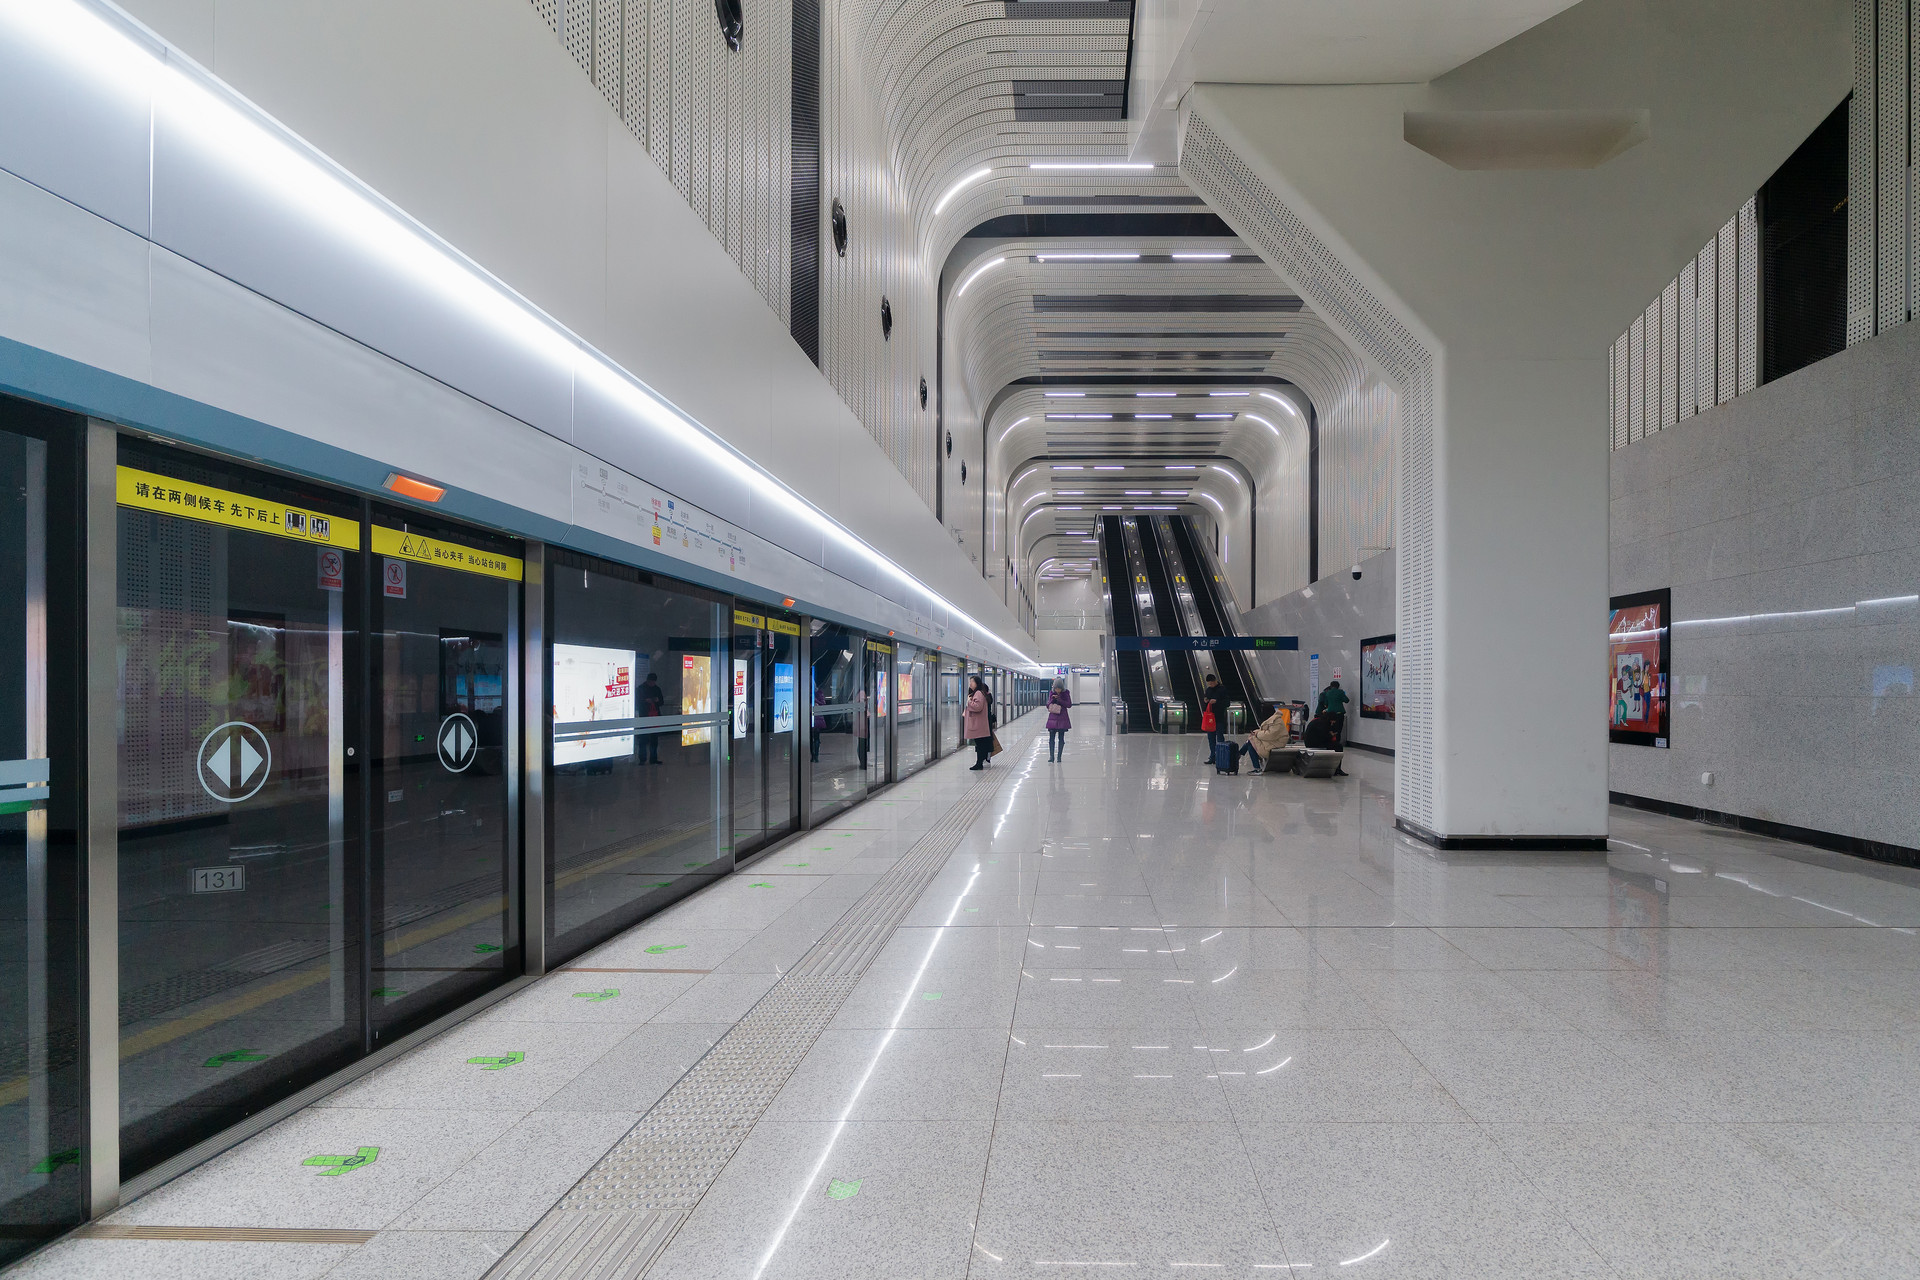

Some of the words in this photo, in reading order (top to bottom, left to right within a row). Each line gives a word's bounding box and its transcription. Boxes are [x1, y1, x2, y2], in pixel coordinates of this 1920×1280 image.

[136, 481, 226, 513] 请在两侧候车
[230, 503, 281, 525] 先下后上
[434, 547, 464, 562] 当心夹手
[468, 554, 508, 571] 当心站台间隙
[200, 870, 236, 889] 131
